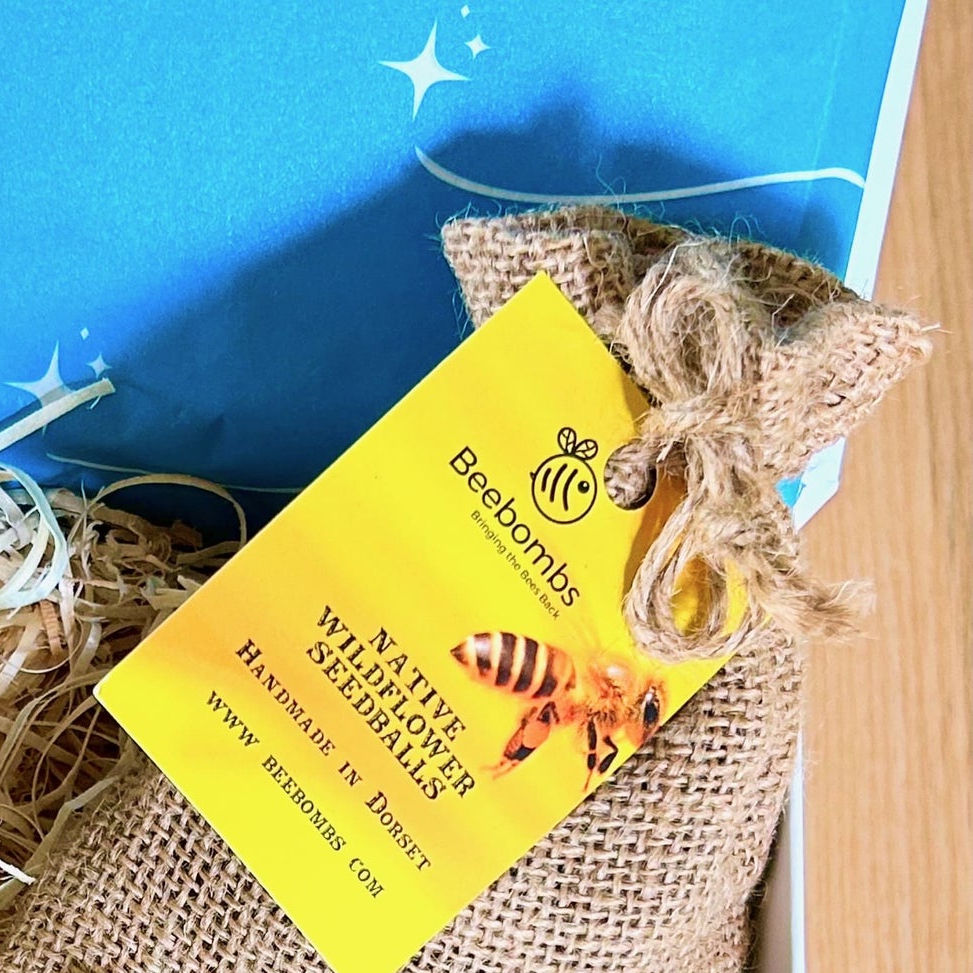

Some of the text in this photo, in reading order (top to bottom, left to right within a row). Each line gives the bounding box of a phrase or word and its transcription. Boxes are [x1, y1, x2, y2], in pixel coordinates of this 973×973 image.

[449, 446, 580, 606] Beebombs
[470, 510, 560, 620] Bringing the Bees Back
[235, 638, 337, 756] HANDMADE
[364, 791, 431, 871] DORSET
[306, 641, 447, 800] SEEDBALLS
[316, 605, 476, 798] WILDFLOWER
[368, 627, 466, 742] NATIVE
[261, 755, 347, 851] BEEBOMBS
[349, 857, 385, 898] COM
